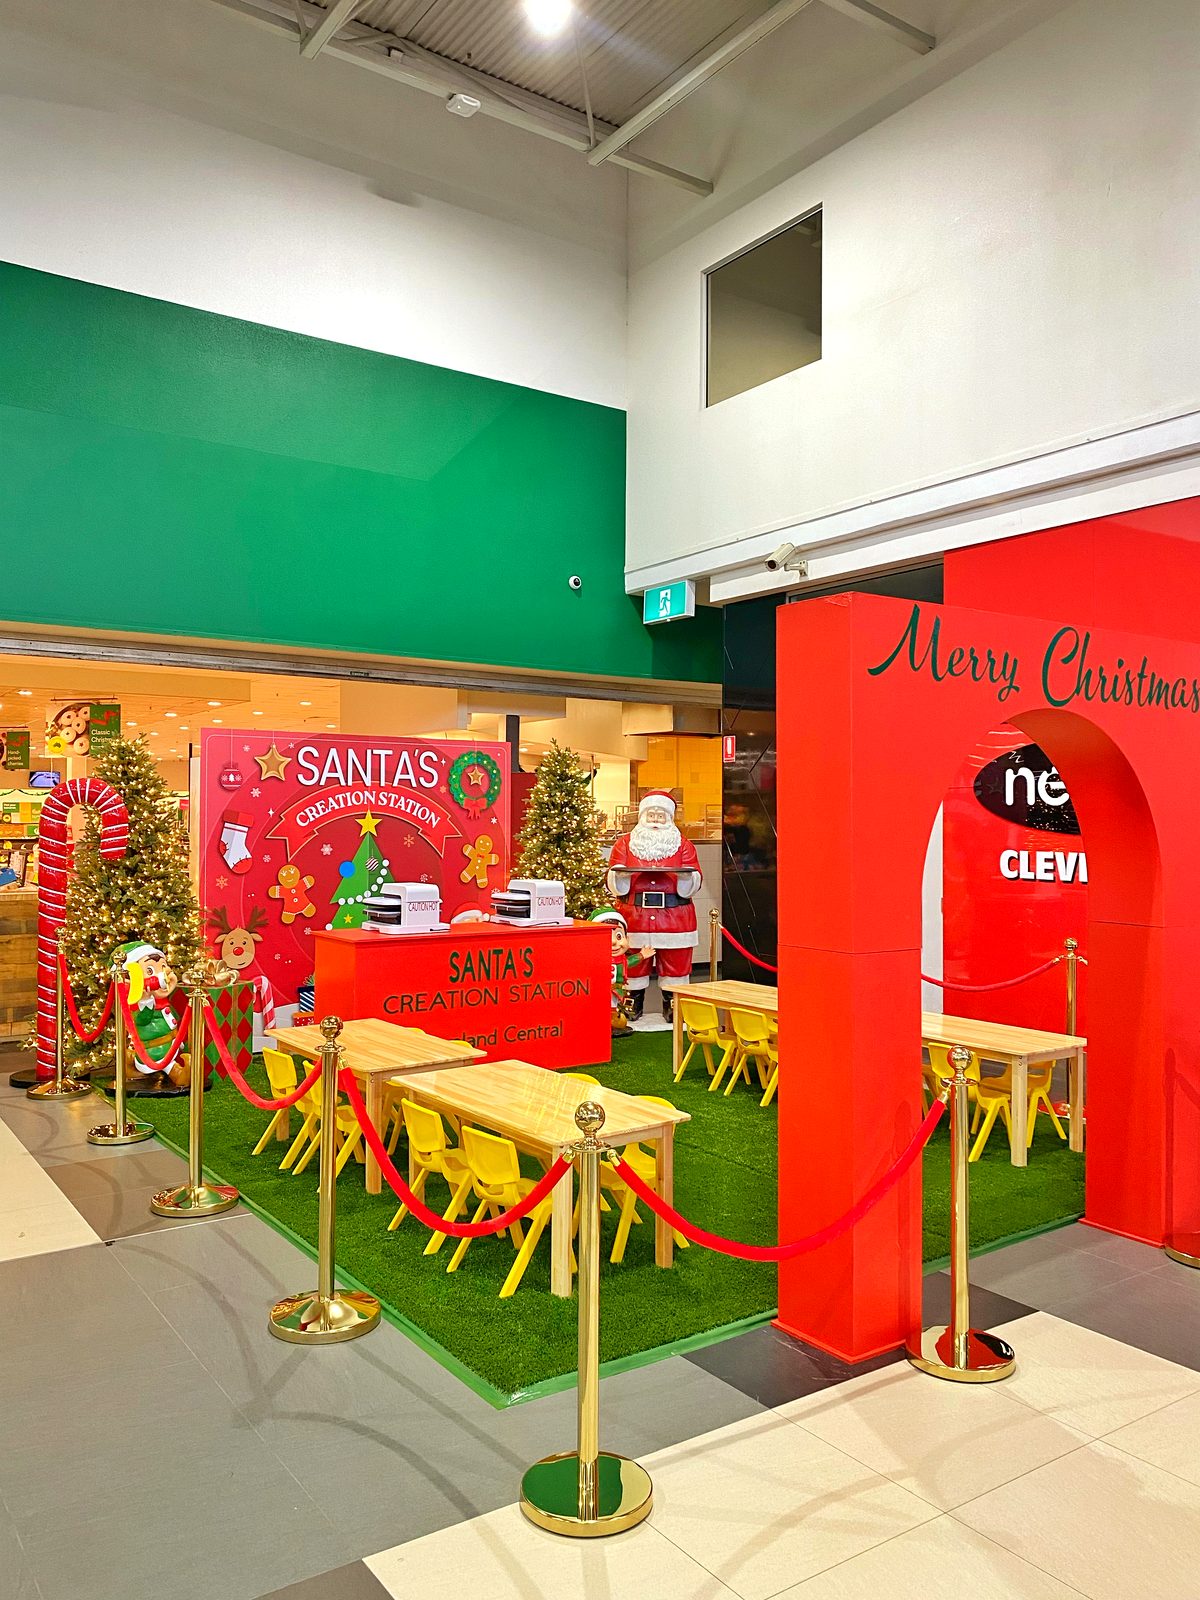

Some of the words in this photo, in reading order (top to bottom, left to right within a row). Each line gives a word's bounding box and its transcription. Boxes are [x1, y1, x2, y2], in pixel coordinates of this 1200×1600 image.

[867, 604, 1021, 702] Merry
[1042, 626, 1200, 713] Christmas
[297, 746, 439, 788] SANTA'S
[296, 790, 376, 827] CREATION
[378, 791, 440, 828] STATION
[408, 901, 429, 911] CAUTION
[449, 947, 534, 983] SANTA'S
[383, 987, 499, 1015] CREATION
[510, 979, 590, 1003] STATION
[503, 1020, 563, 1043] Central
